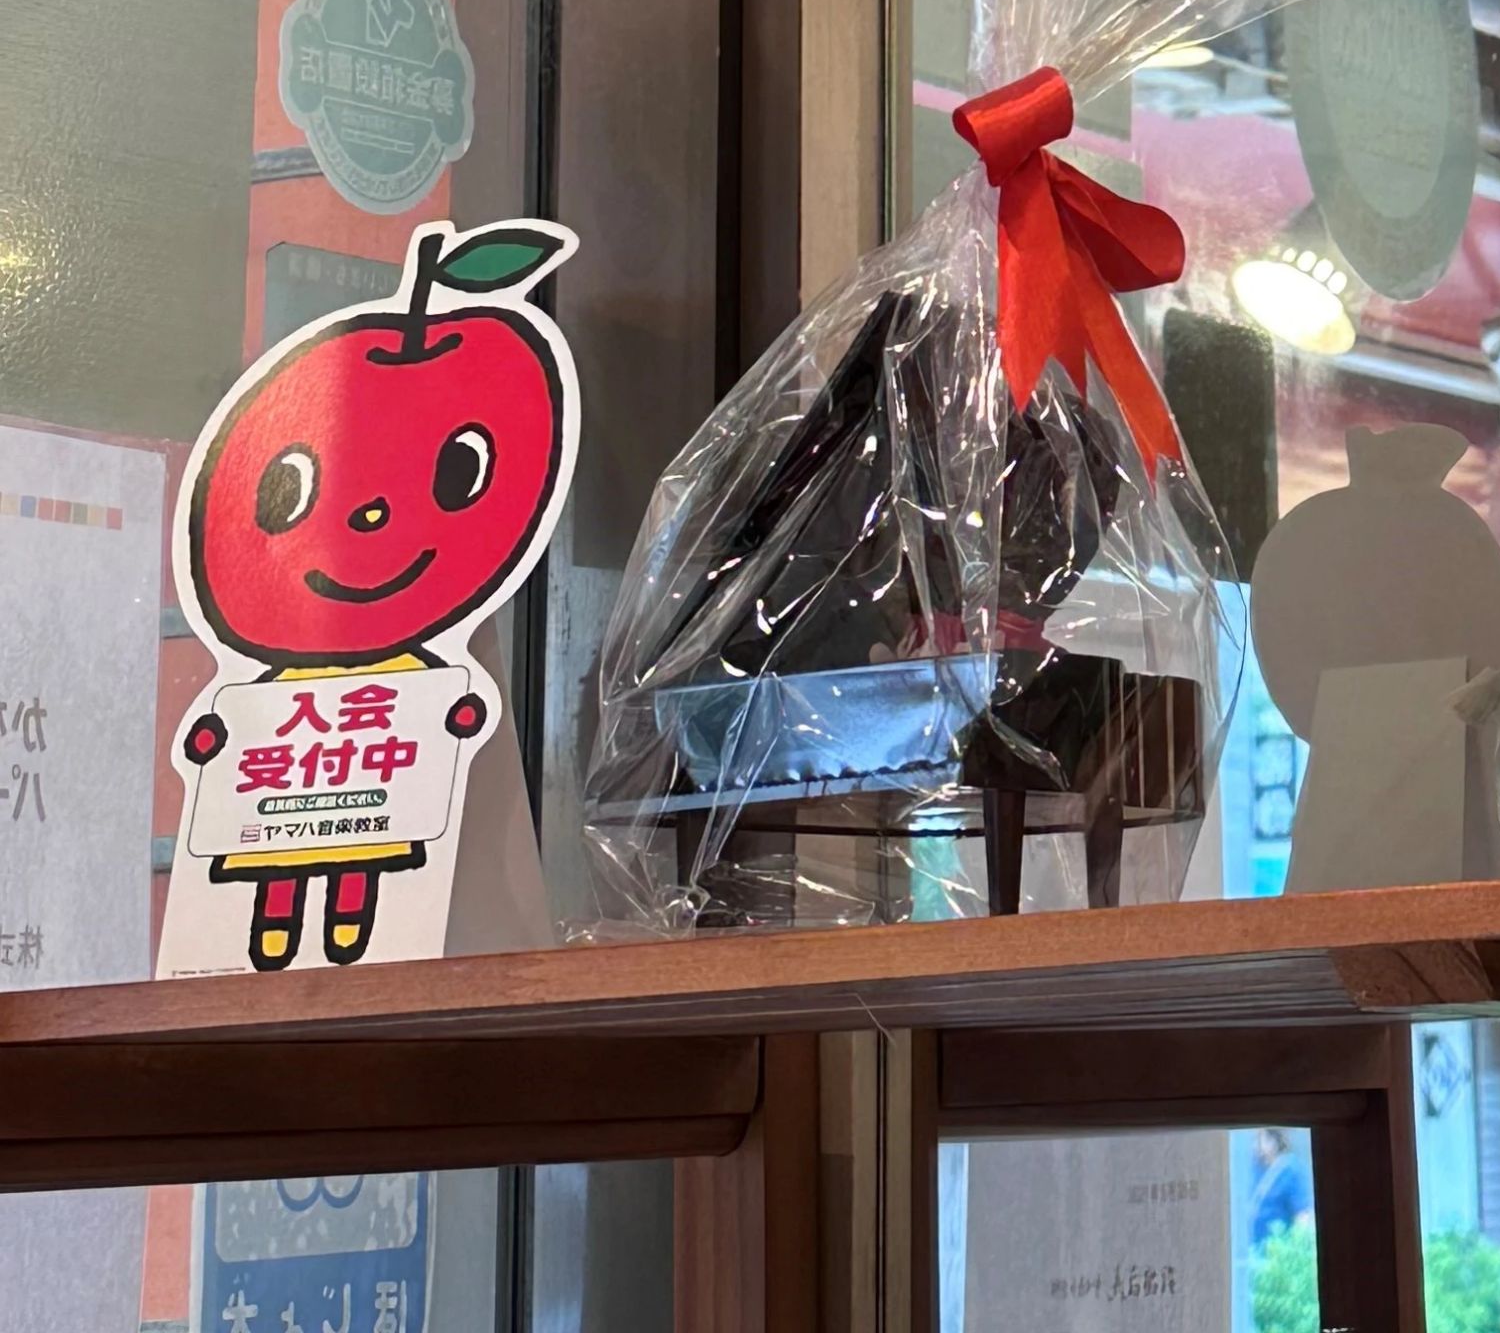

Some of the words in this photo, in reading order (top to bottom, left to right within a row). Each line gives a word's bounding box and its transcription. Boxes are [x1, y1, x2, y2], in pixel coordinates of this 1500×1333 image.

[275, 683, 399, 738] 入会
[235, 735, 419, 794] 受付中
[263, 814, 392, 841] ヤマハ音楽教室
